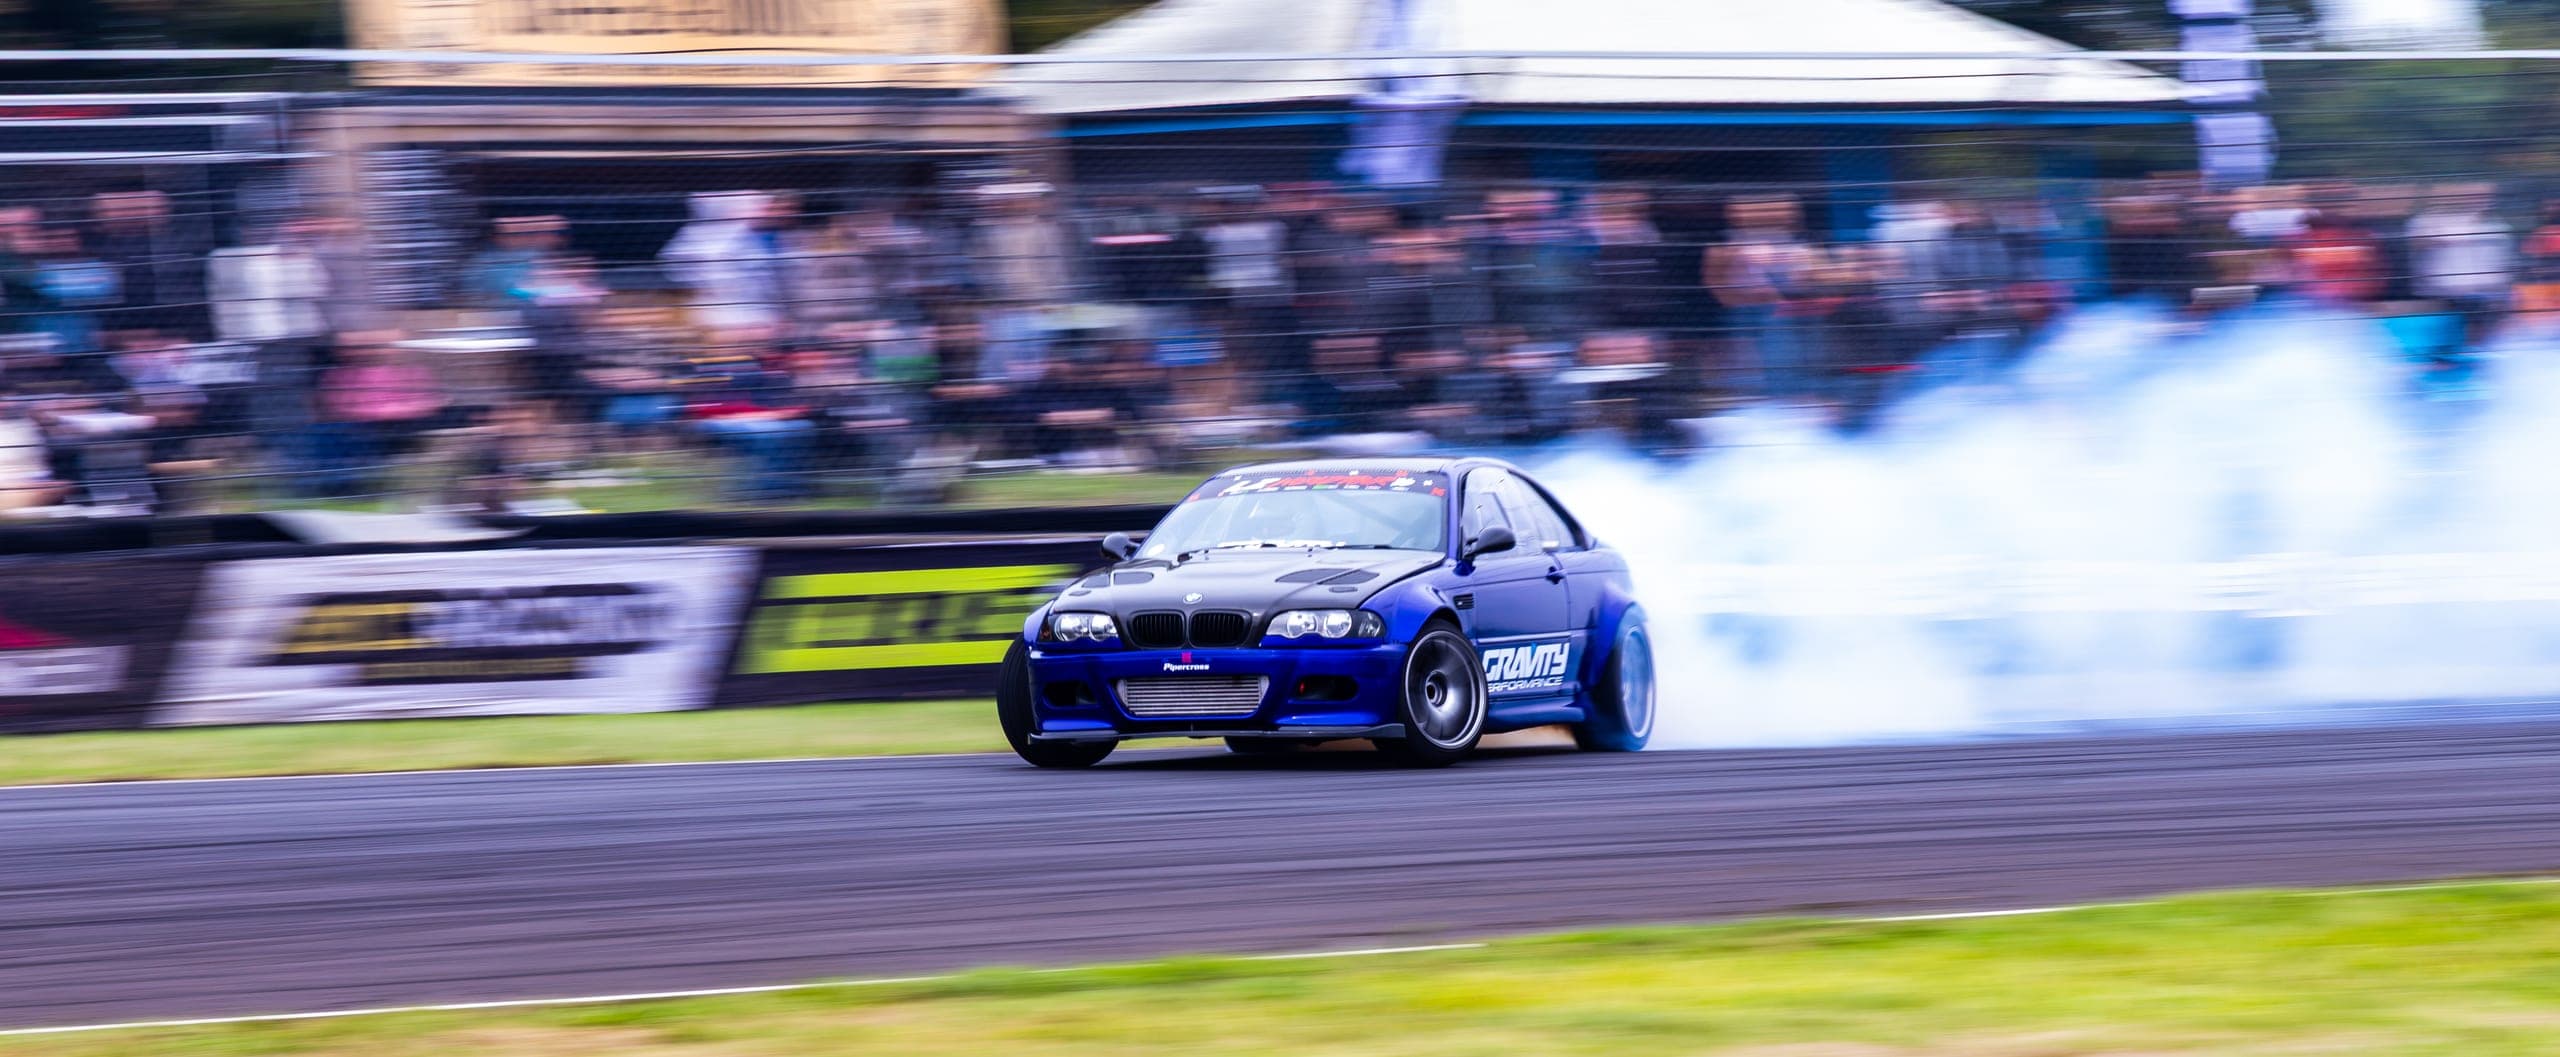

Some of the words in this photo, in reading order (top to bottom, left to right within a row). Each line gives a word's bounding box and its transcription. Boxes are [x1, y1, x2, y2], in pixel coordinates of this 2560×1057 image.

[1163, 662, 1210, 673] Pipercross
[1482, 642, 1570, 682] GRAVITY
[1487, 676, 1564, 693] ERFORMANCE
